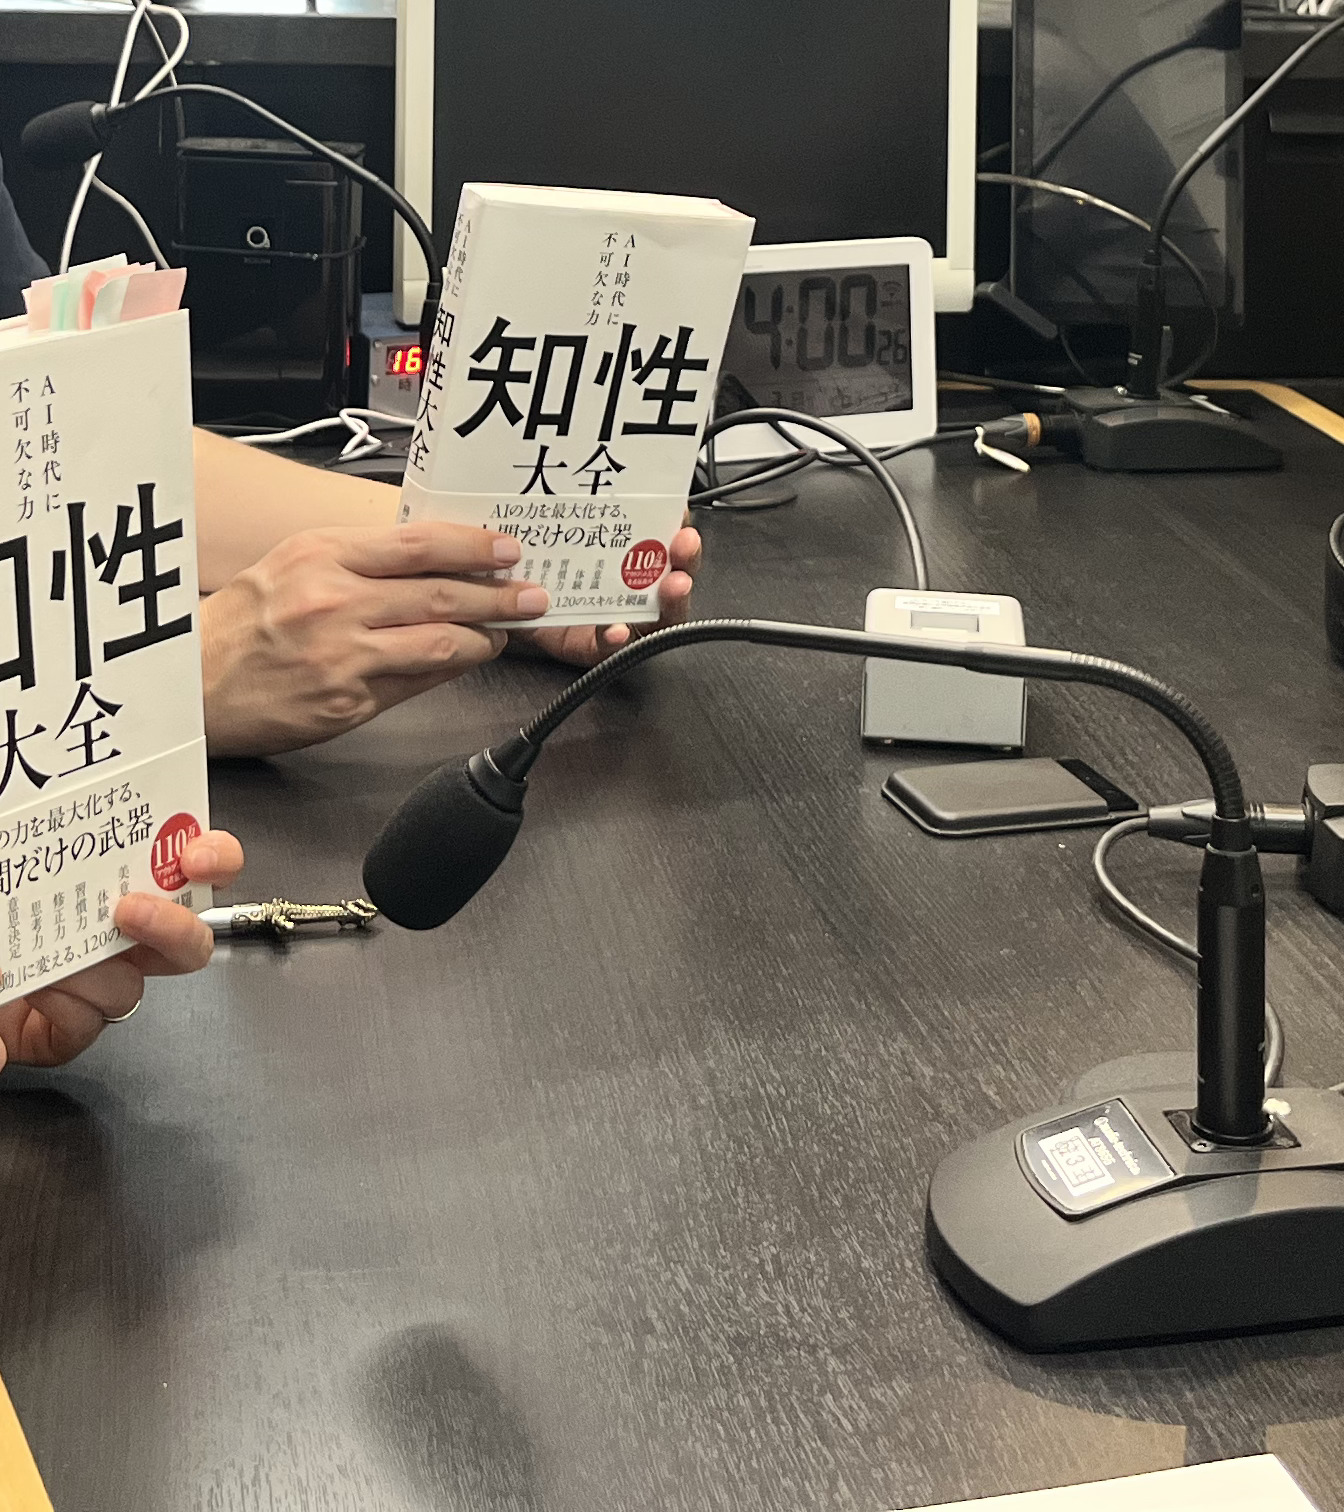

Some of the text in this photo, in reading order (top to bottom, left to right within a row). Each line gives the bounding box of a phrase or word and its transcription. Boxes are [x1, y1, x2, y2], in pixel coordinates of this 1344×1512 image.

[585, 231, 619, 326] 不可欠な力
[606, 231, 637, 326] AI時代に
[743, 273, 878, 372] 4:00
[392, 346, 422, 375] 16
[408, 303, 456, 473] 知性大全
[452, 315, 711, 442] 知性
[9, 378, 34, 524] 不可欠な力
[40, 374, 62, 513] AI時代に
[512, 443, 627, 496] 大全
[489, 501, 629, 520] AIの力を最大化する、
[7, 896, 22, 961] 意思決定
[30, 899, 44, 952] 思考力
[53, 891, 66, 942] 修正力
